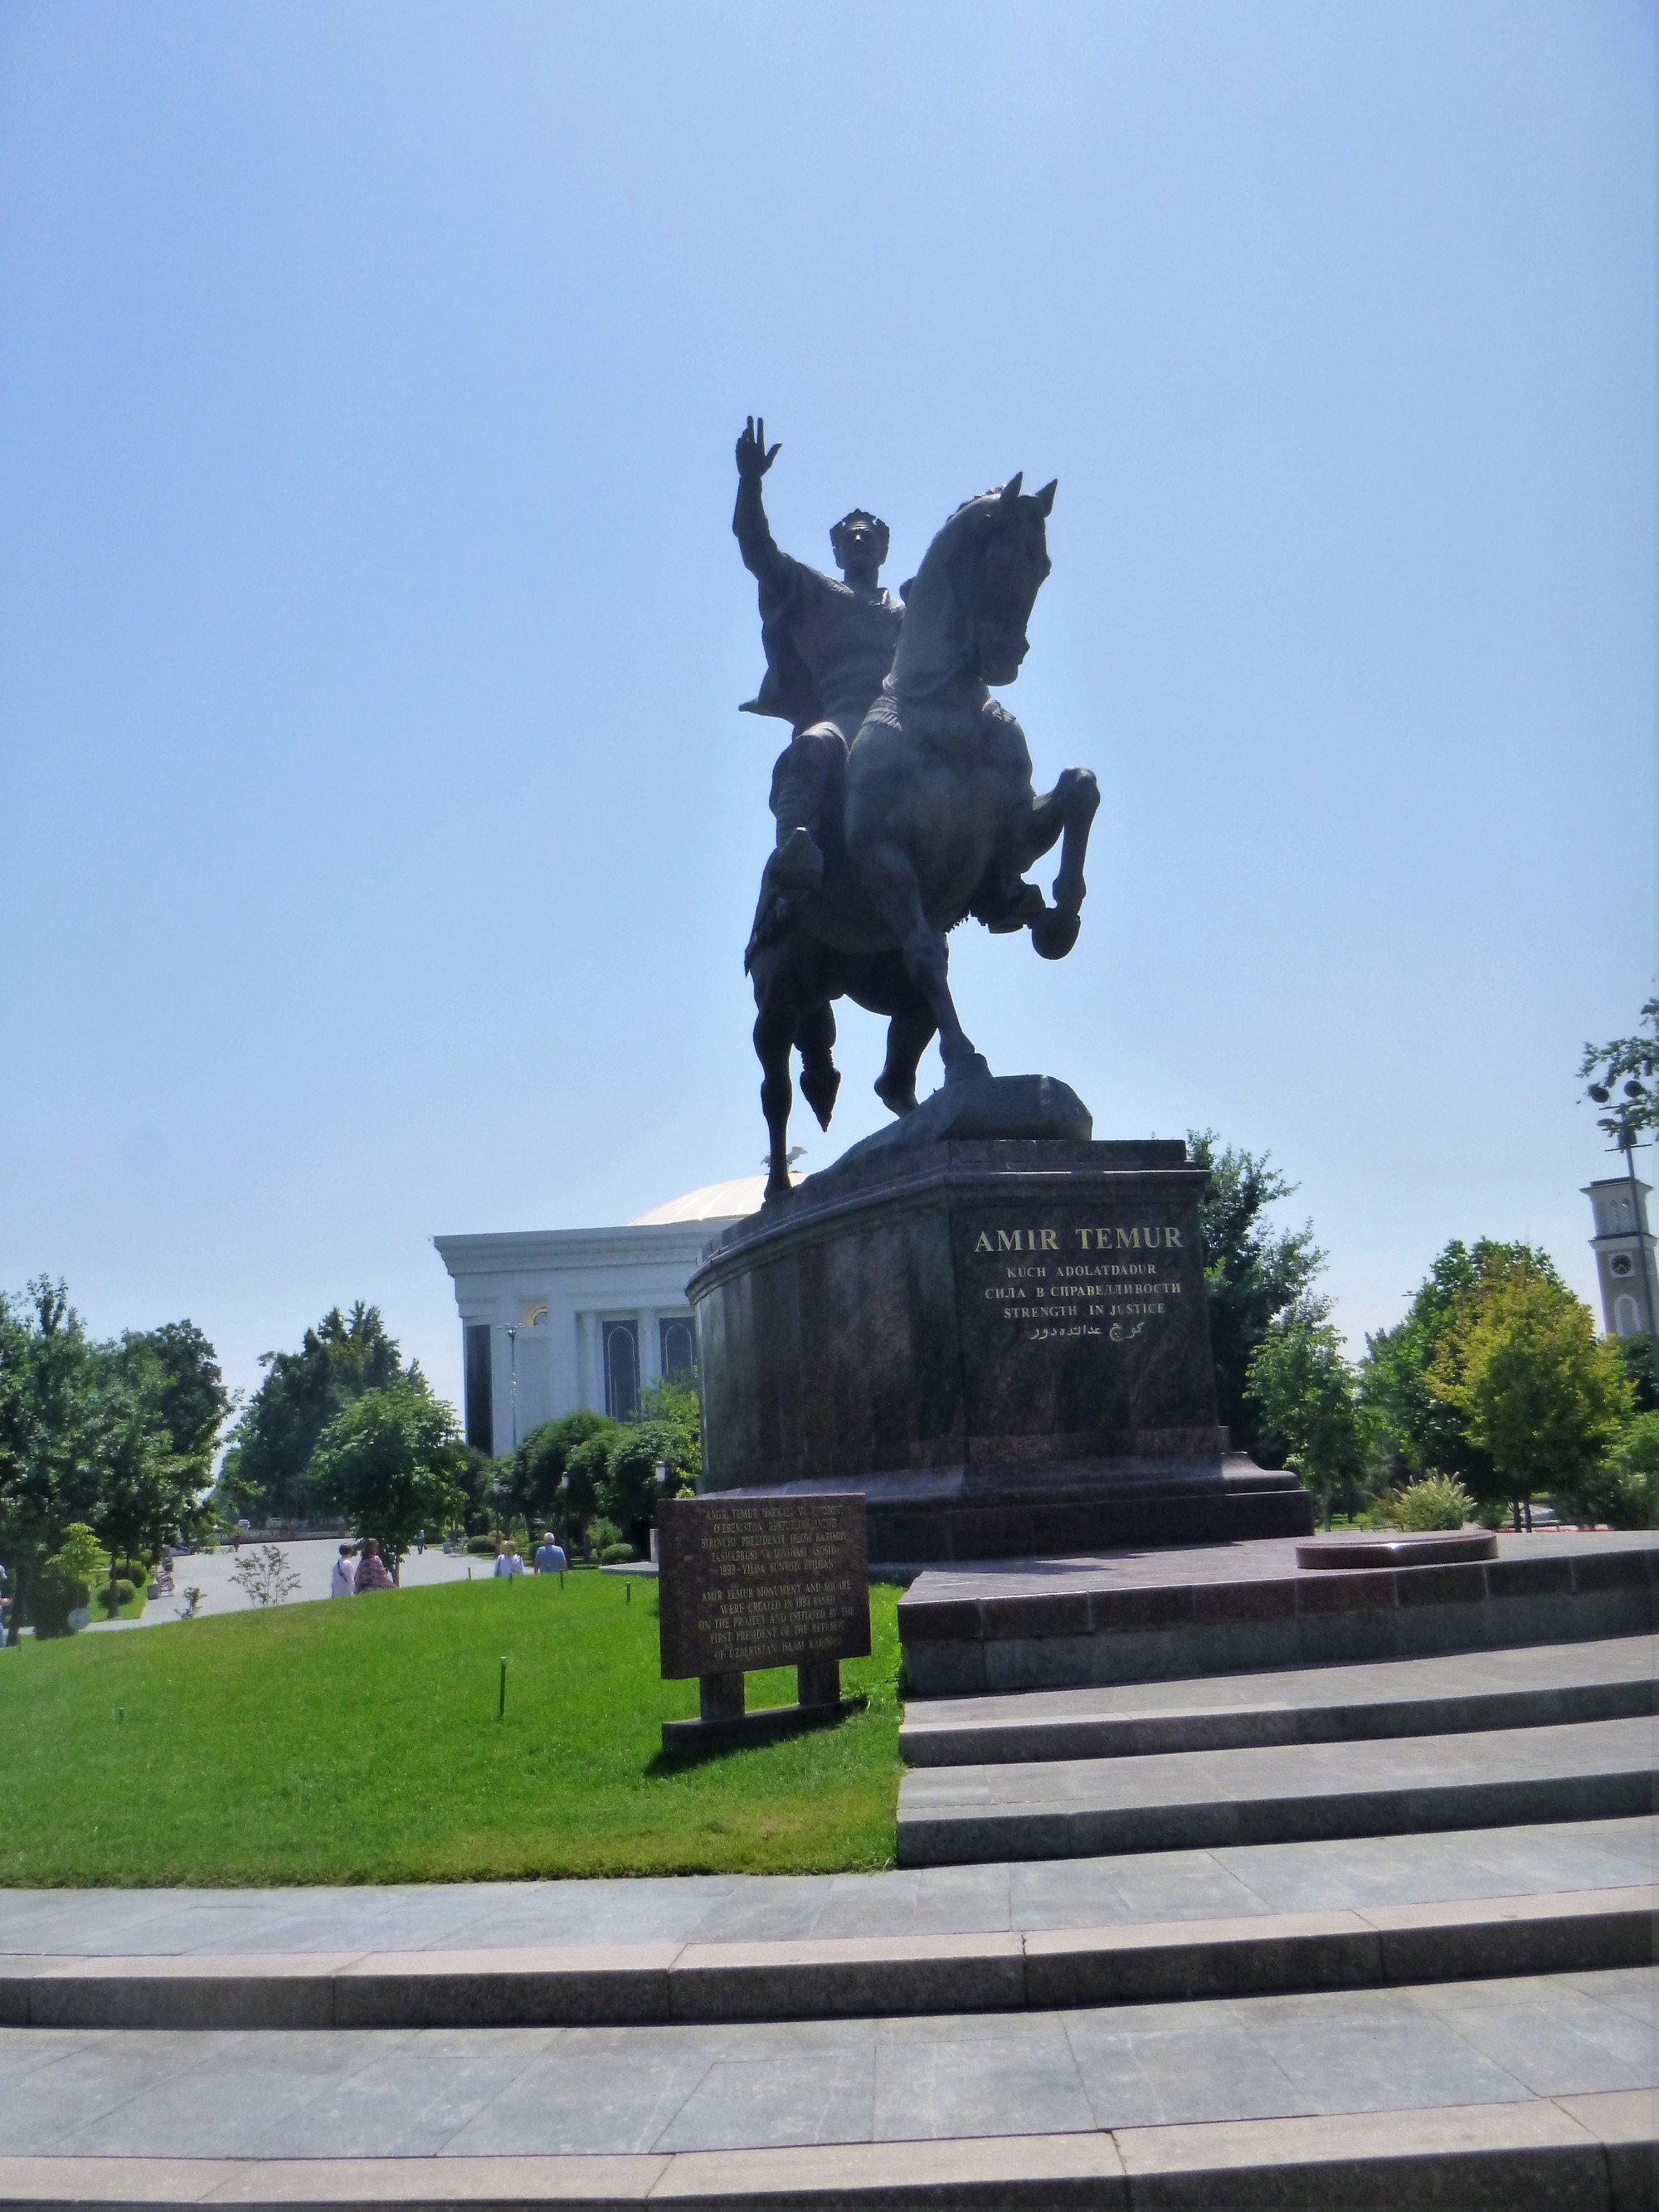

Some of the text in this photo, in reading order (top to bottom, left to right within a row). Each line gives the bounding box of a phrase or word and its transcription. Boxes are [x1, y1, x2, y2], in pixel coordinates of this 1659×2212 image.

[974, 1226, 1184, 1252] AMIR TEMUR
[1006, 1264, 1157, 1279] KUCH ADOLATDADUR
[985, 1283, 1181, 1299] СИЛА В СПРАВЕДЛИВОСТИ
[1004, 1303, 1165, 1319] STRENGTH IN JUSTICE
[707, 1509, 727, 1520] AMIR
[732, 1508, 757, 1519] TEMUR
[700, 1537, 736, 1548] BIRINCHI
[741, 1534, 785, 1547] PREZIDENTI
[702, 1590, 722, 1602] AMIR
[727, 1588, 754, 1600] TEMUR
[757, 1584, 801, 1597] MONUMENT
[805, 1582, 821, 1593] AND
[720, 1603, 744, 1615] WERE
[747, 1600, 781, 1613] CREATED
[784, 1599, 793, 1609] IN
[698, 1620, 711, 1630] ON
[714, 1618, 730, 1630] THE
[733, 1615, 765, 1627] PROJECT
[771, 1613, 786, 1624] AND
[790, 1609, 825, 1621] INITIATED
[710, 1631, 732, 1644] FIRST
[736, 1627, 776, 1641] PRESIDENT
[781, 1625, 791, 1636] OF
[794, 1624, 808, 1635] THE
[714, 1649, 724, 1659] OF
[729, 1644, 776, 1658] UZBEKISTAN
[782, 1640, 805, 1652] ISLAM
